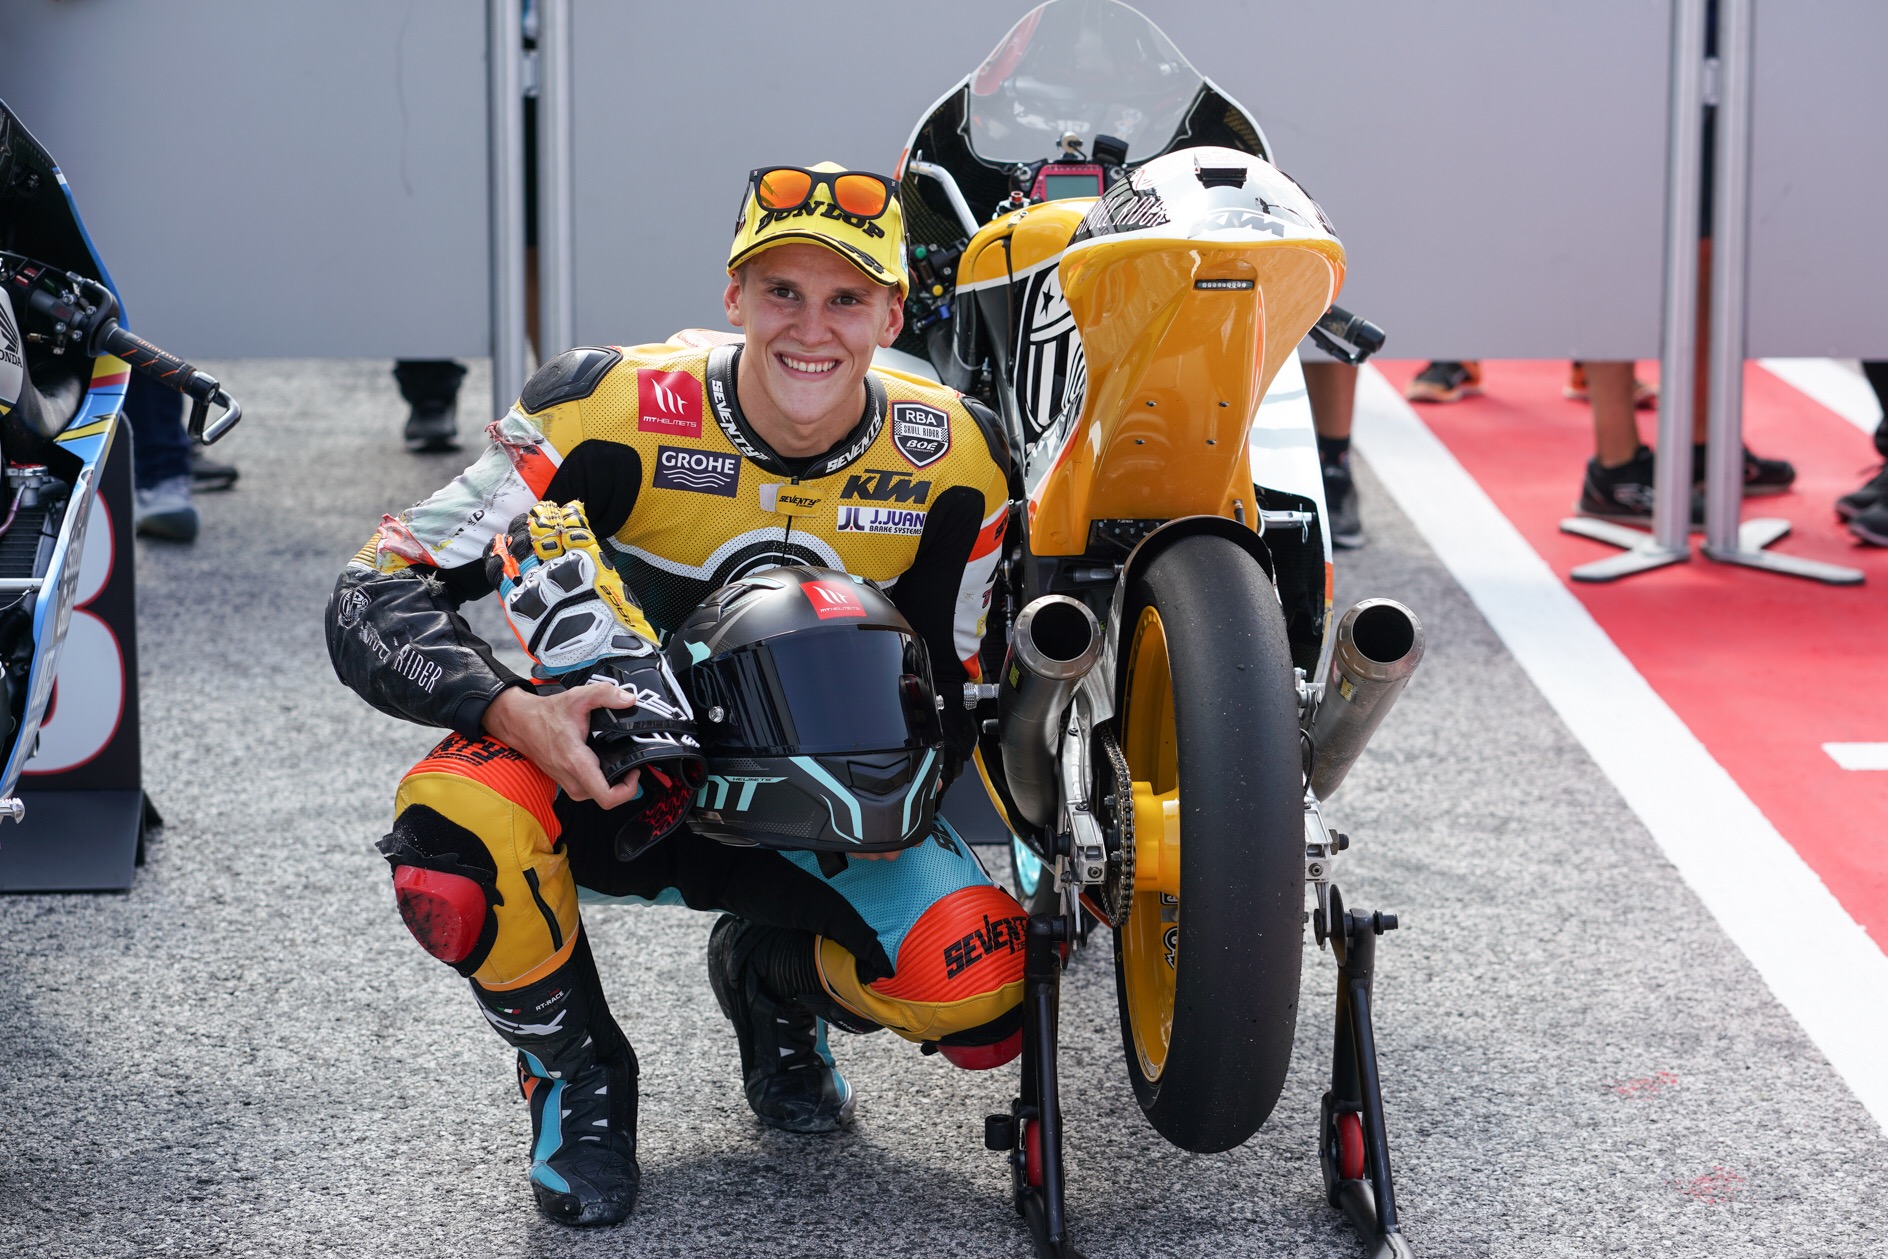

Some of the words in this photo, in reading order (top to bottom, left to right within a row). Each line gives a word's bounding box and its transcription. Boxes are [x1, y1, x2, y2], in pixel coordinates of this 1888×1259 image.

[0, 348, 23, 369] ONDA
[905, 409, 938, 426] RBA
[903, 424, 921, 436] SKULL
[661, 450, 736, 475] GROHE
[839, 468, 933, 505] KTM
[779, 494, 817, 507] SEVENTY
[869, 525, 893, 533] BRAKE
[893, 526, 923, 535] SYSTEMS
[393, 643, 443, 694] RIDER
[943, 913, 1027, 981] SEVENT
[535, 990, 564, 1012] RT-RACE
